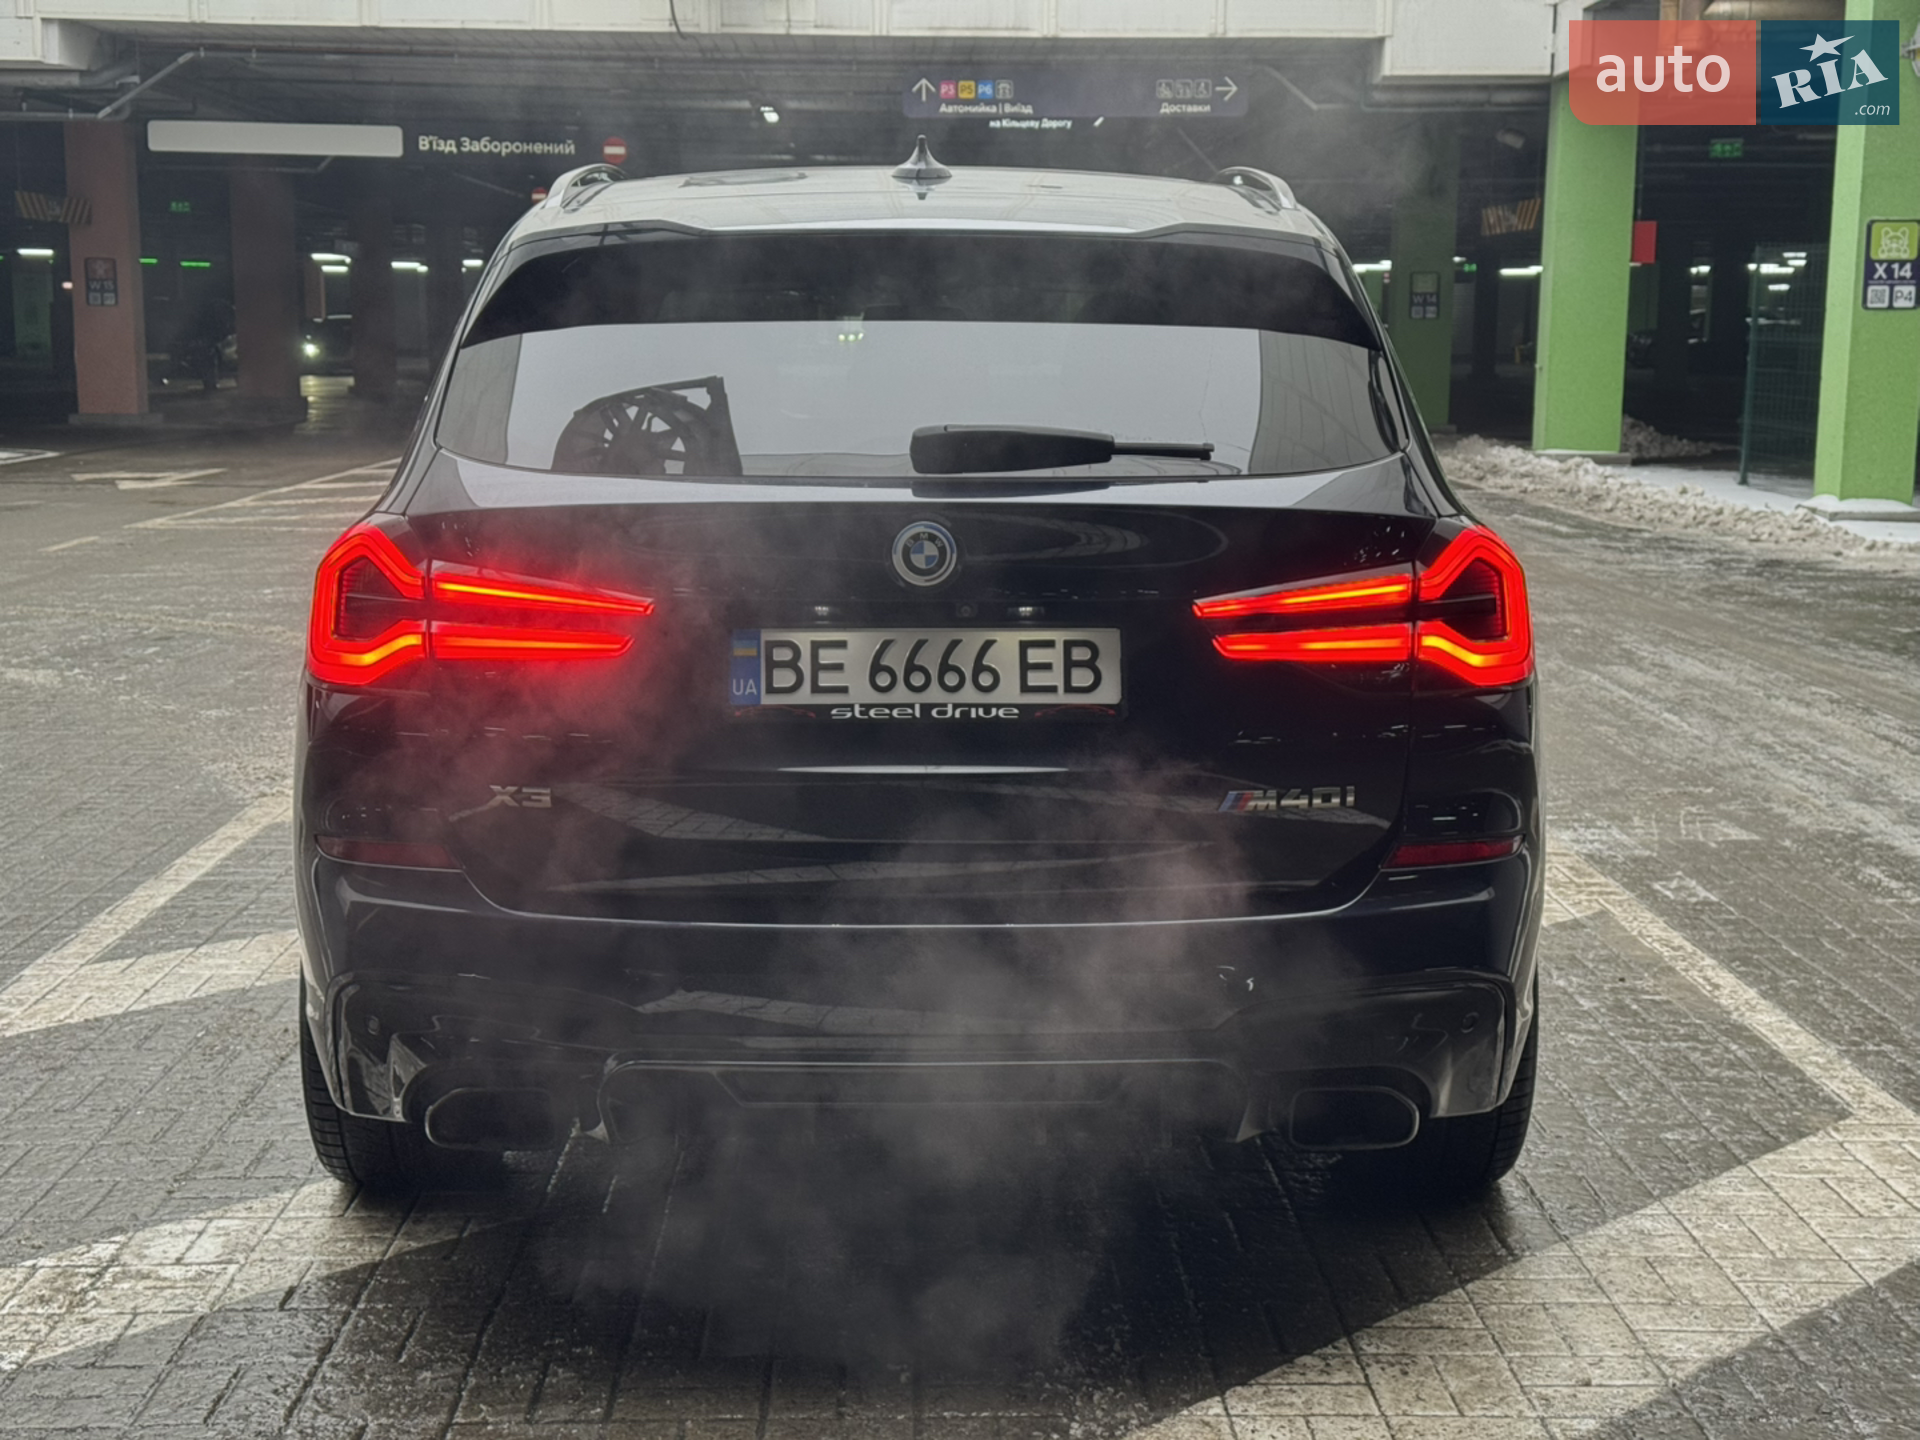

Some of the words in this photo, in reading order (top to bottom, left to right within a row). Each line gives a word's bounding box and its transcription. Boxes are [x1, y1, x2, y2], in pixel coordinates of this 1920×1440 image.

[940, 82, 956, 97] P3
[959, 83, 974, 97] P5
[978, 83, 993, 97] P6
[939, 103, 997, 114] Автомийка
[1160, 102, 1211, 115] Доставки
[418, 135, 458, 154] В'їзд
[460, 137, 576, 157] Заборонений
[1873, 262, 1888, 280] X
[1890, 262, 1913, 280] 14
[1895, 289, 1913, 303] P4
[905, 532, 945, 548] BMW
[764, 639, 850, 695] BE
[868, 638, 1001, 694] 6666
[1018, 639, 1103, 695] EB
[732, 678, 757, 696] UA
[830, 703, 921, 719] steel
[931, 704, 1020, 719] drive
[489, 785, 552, 808] X3
